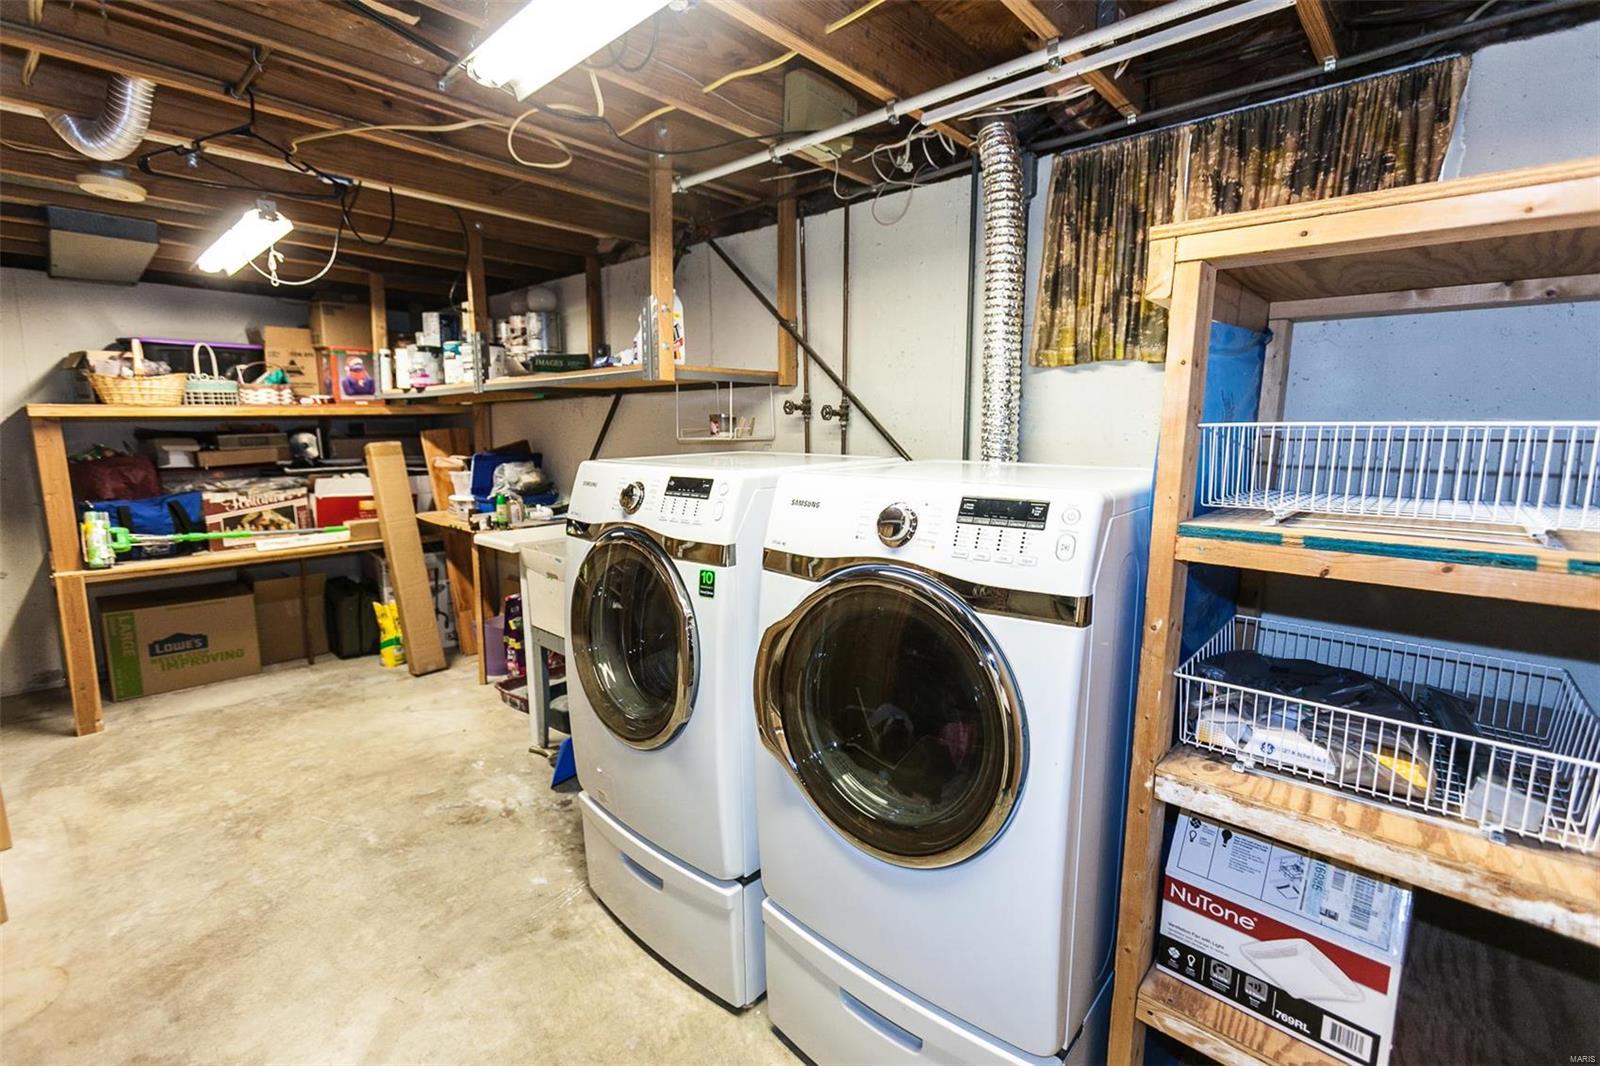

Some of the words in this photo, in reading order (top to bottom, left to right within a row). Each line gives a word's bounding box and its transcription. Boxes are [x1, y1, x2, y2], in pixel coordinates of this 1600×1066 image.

[791, 499, 821, 508] SAMSUNG
[701, 571, 714, 585] 10
[118, 615, 136, 657] LARGE
[159, 649, 245, 672] IMPROVING
[1275, 1009, 1311, 1034] 769RL
